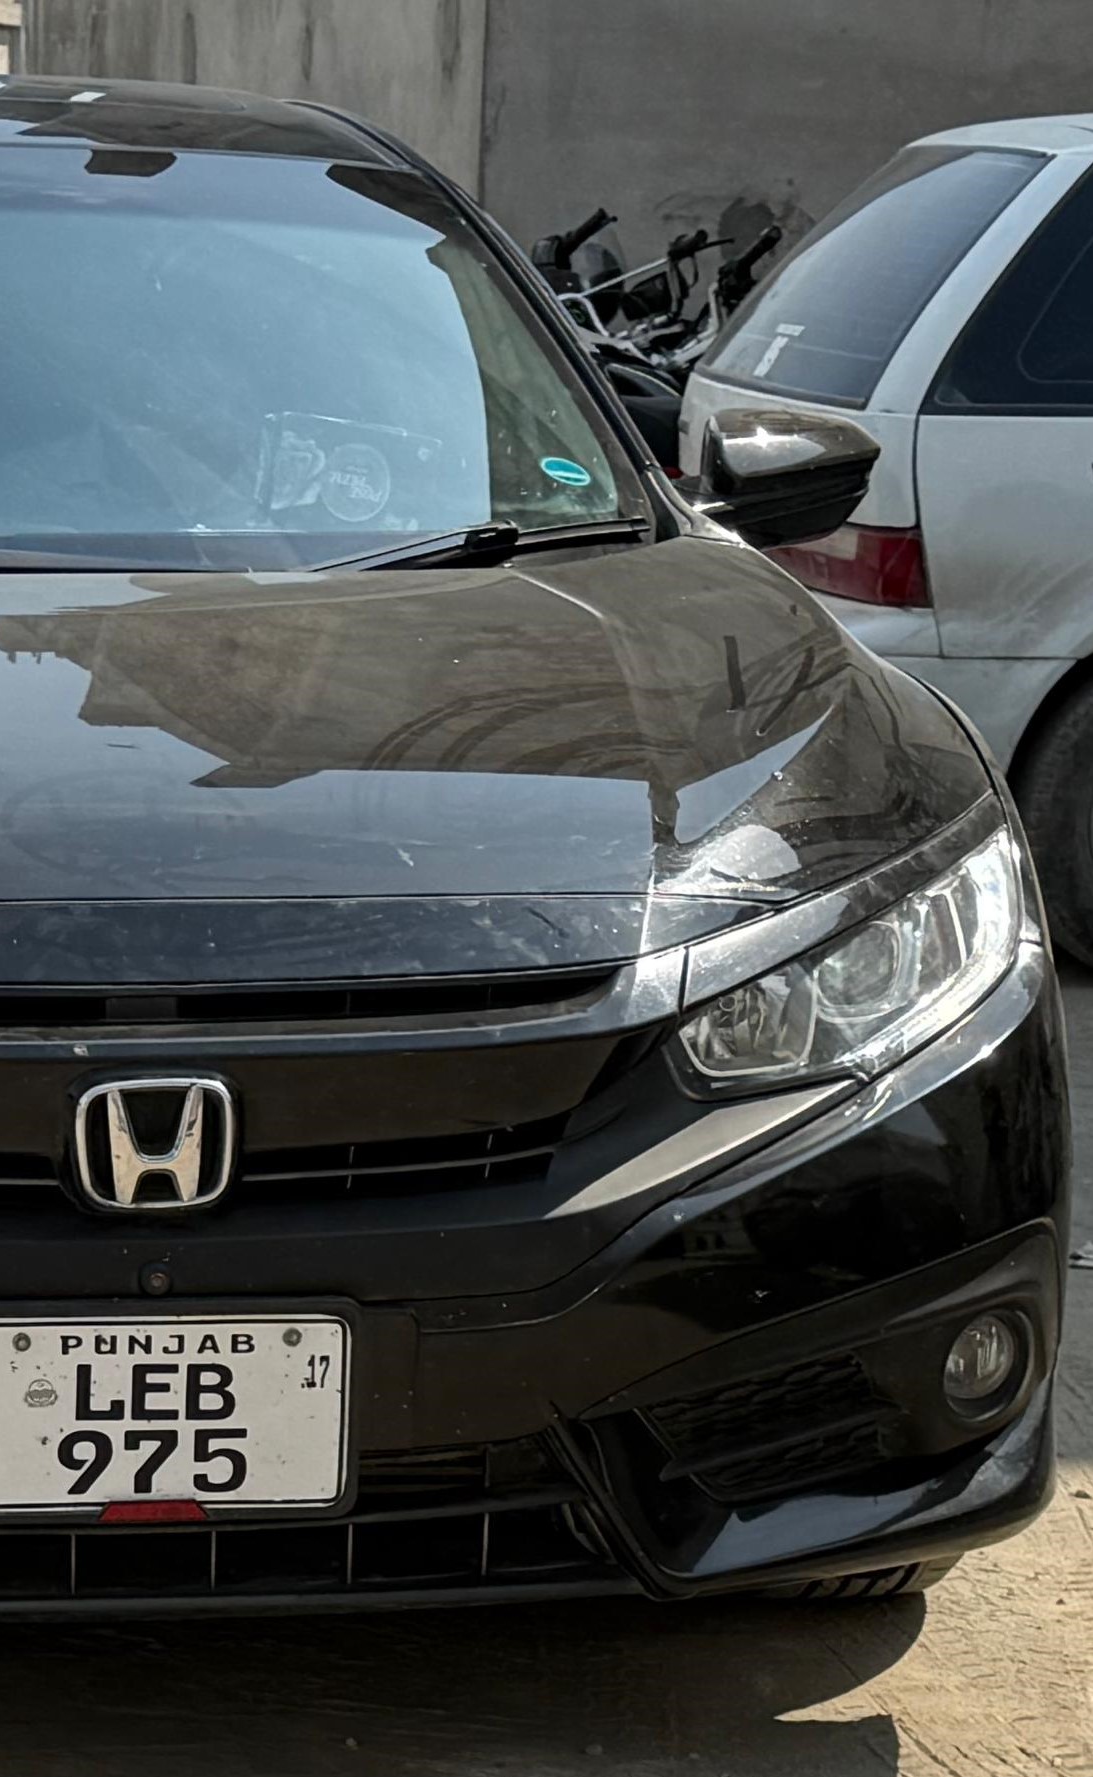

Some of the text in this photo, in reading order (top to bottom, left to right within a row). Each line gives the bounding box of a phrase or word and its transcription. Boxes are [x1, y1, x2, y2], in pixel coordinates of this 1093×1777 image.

[60, 1333, 255, 1356] PUNJAB
[75, 1362, 236, 1421] LEB
[57, 1427, 248, 1495] 975
